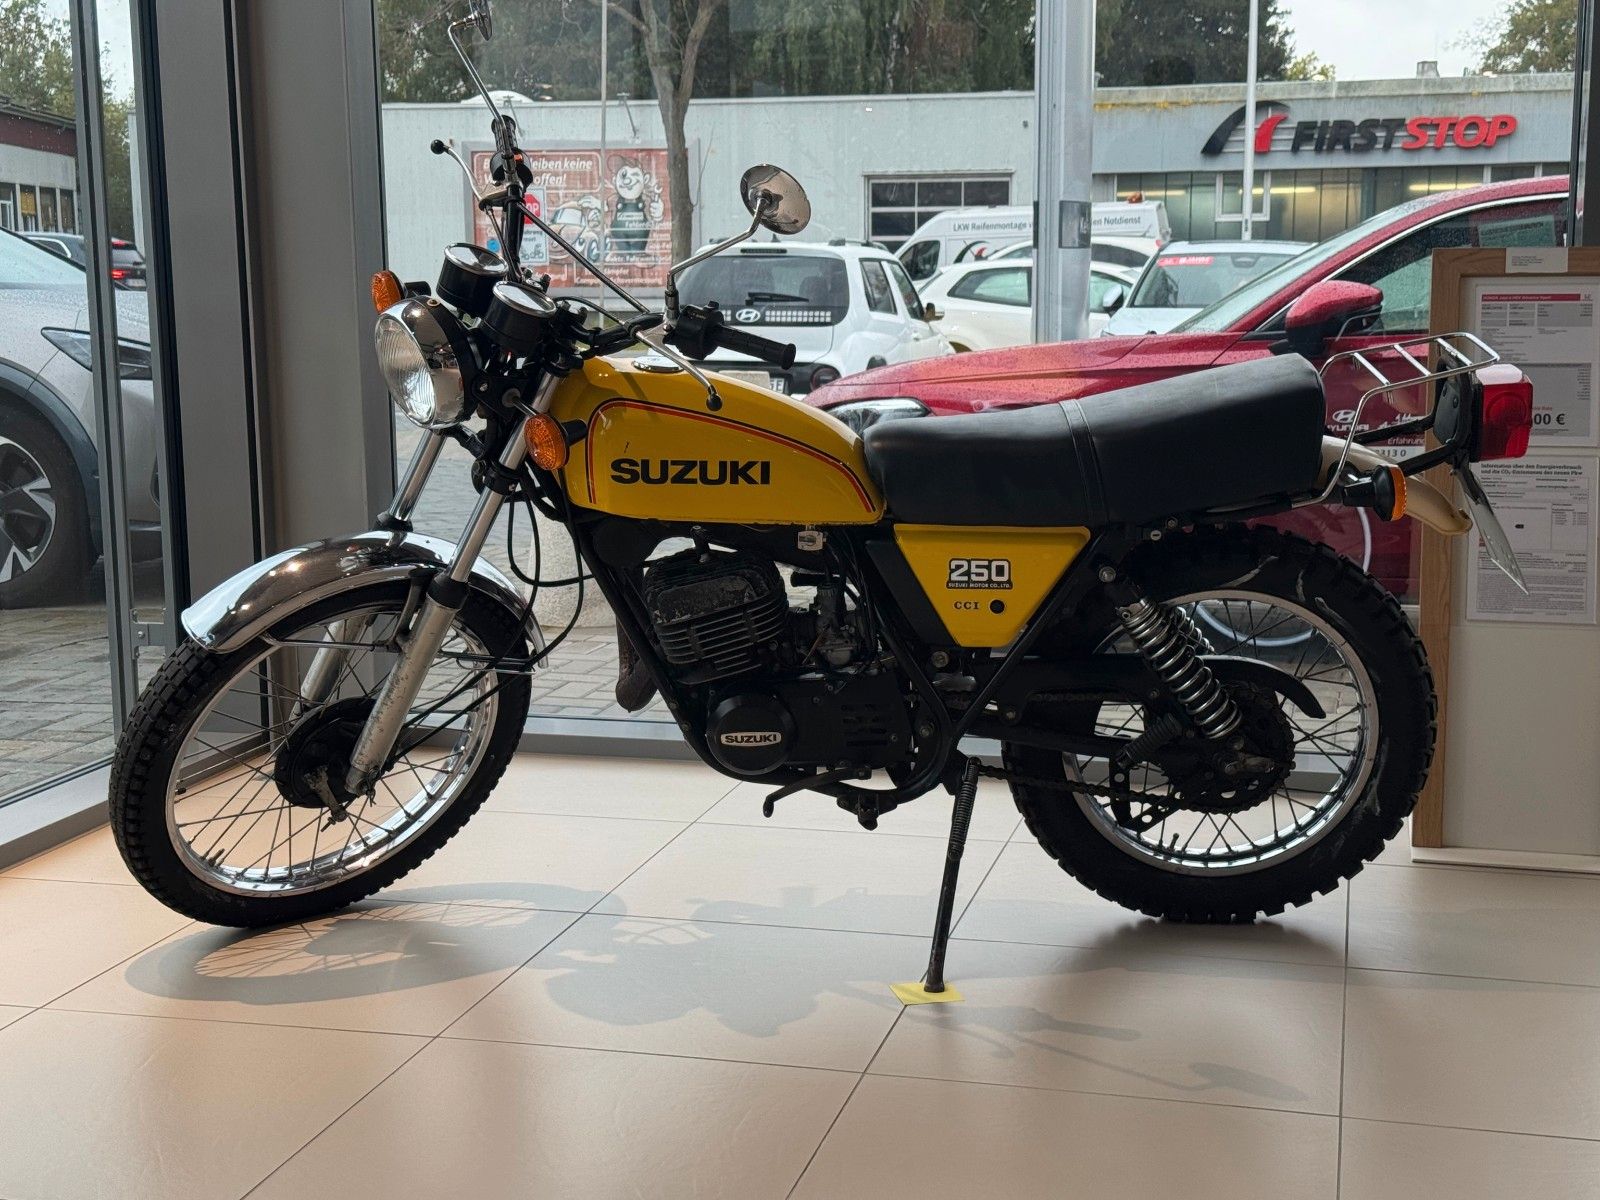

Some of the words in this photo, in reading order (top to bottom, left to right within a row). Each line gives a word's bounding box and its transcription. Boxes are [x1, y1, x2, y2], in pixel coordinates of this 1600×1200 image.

[530, 157, 562, 170] leiben
[563, 157, 593, 170] keine
[533, 172, 567, 186] offen!
[952, 223, 970, 232] LKW
[971, 222, 1027, 231] Reifenmontage
[1103, 215, 1141, 225] Notdienst
[1556, 413, 1565, 425] €
[610, 458, 771, 486] SUZUKI
[950, 560, 1009, 582] 250
[954, 602, 980, 610] CCI
[725, 734, 777, 744] SUZUKI
